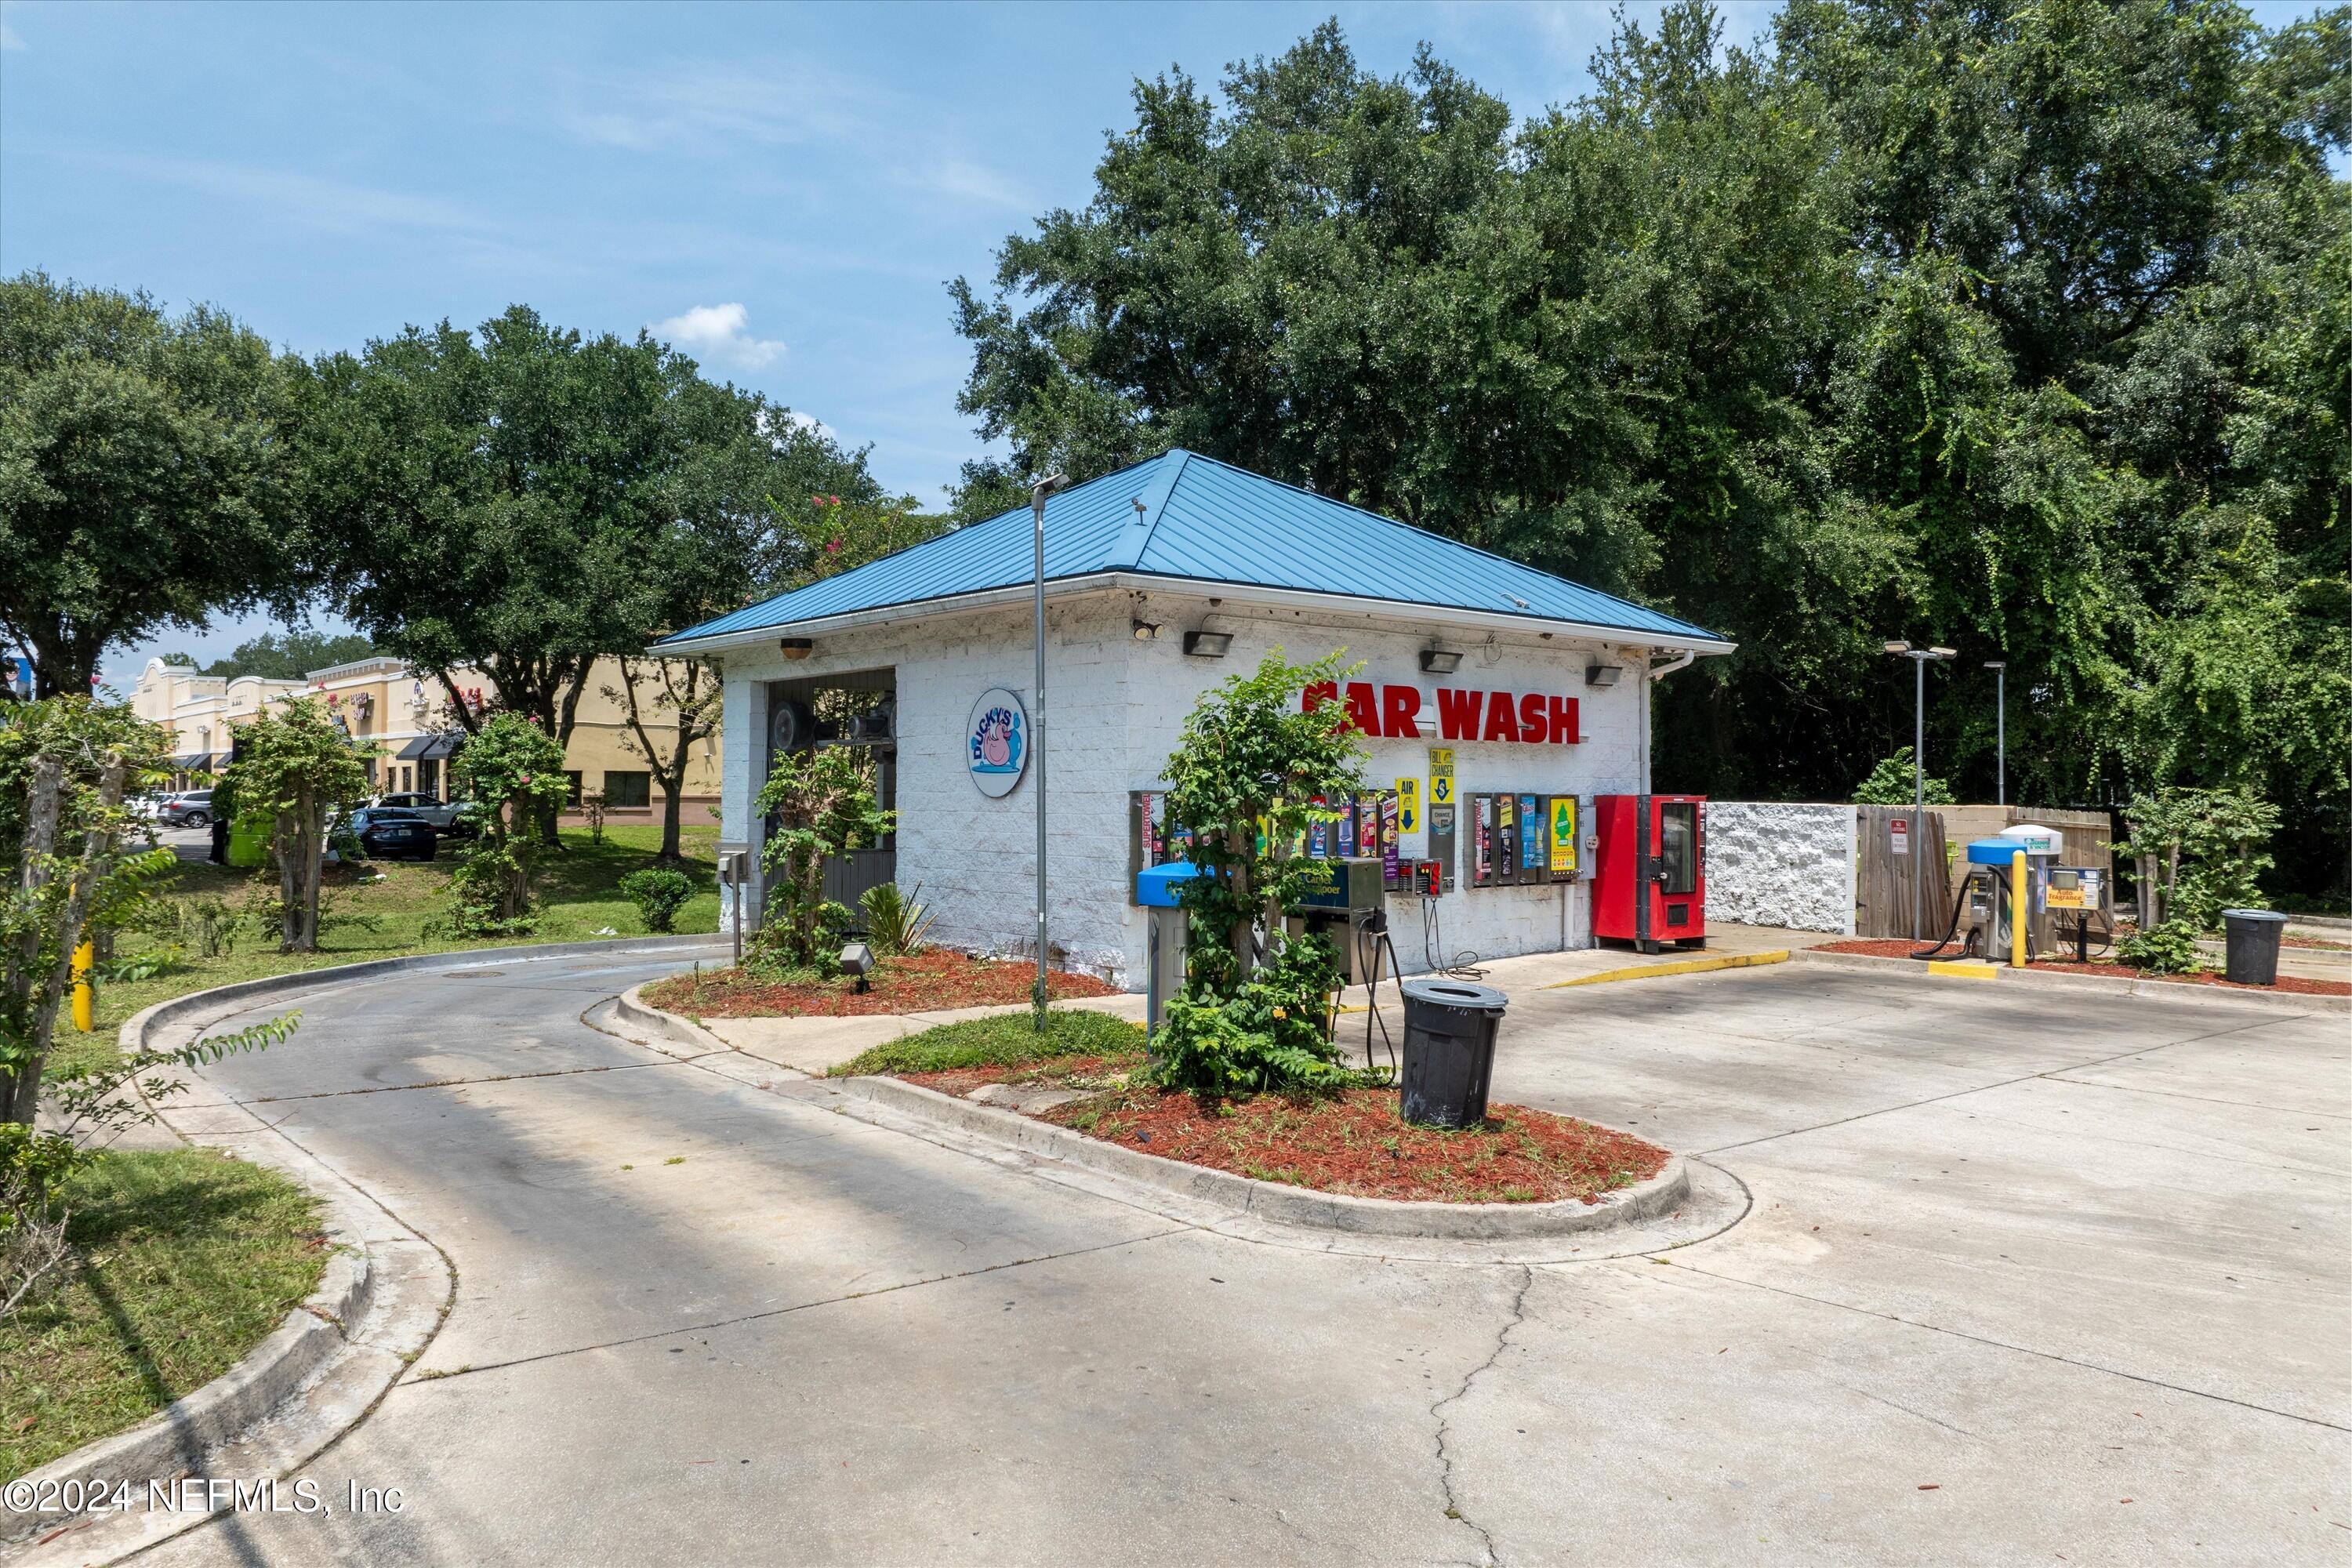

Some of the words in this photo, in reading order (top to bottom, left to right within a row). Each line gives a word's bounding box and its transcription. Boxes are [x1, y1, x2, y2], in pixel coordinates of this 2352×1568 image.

[1302, 681, 1421, 738] CAR
[1437, 688, 1579, 745] WASH
[974, 708, 1011, 760] DUCKY'S
[1432, 750, 1442, 764] BILL
[1432, 764, 1454, 778] CHANGER
[1401, 781, 1414, 794] AIR
[1142, 794, 1151, 848] SUPERTOWEL
